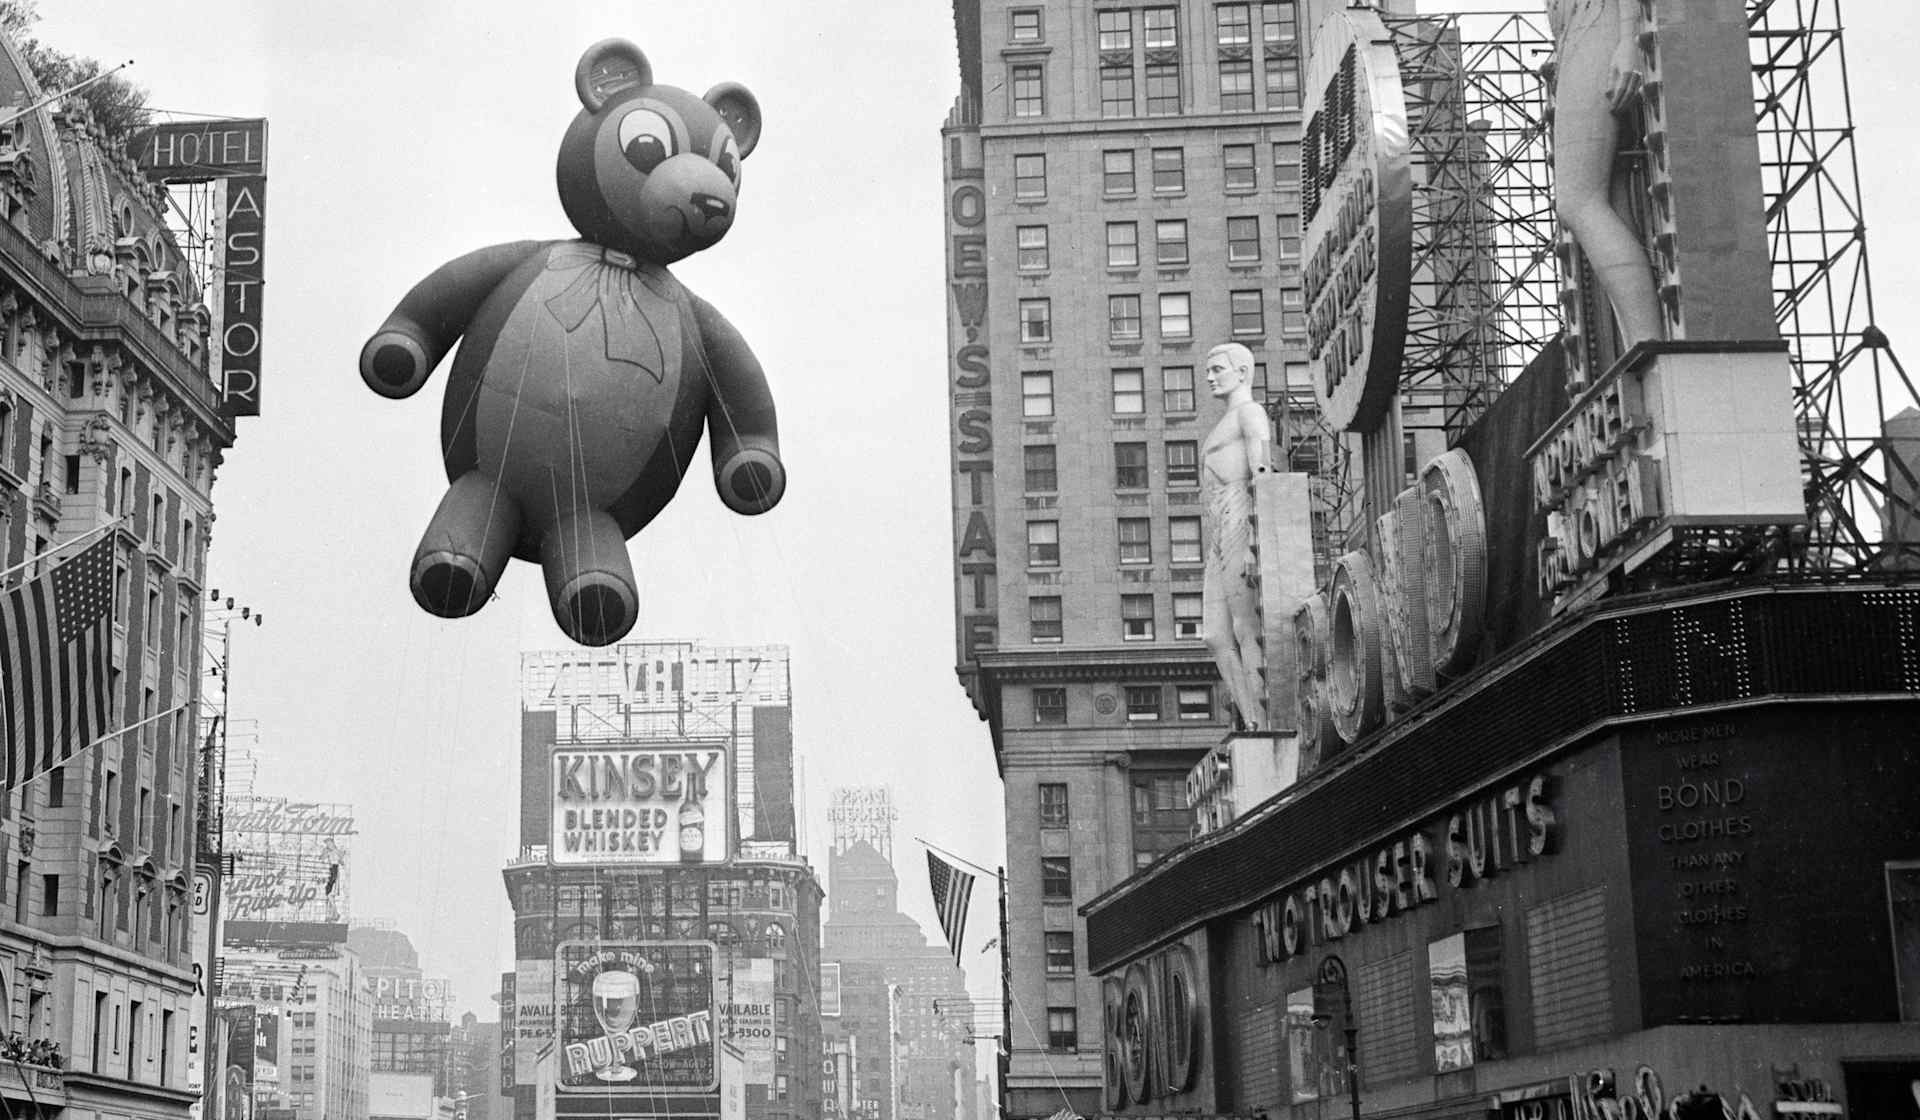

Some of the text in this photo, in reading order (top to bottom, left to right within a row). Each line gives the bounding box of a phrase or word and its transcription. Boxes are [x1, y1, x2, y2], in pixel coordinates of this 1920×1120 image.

[153, 128, 262, 166] HOTEL
[222, 186, 262, 403] ASTOR
[949, 136, 999, 662] LOEW'S STATE
[1296, 447, 1488, 770] BOND
[1656, 724, 1737, 745] MORE MEN
[1675, 751, 1720, 769] WEAR
[558, 752, 719, 801] KINSEY
[1656, 778, 1744, 809] BOND
[565, 808, 668, 831] BLENDED
[1657, 815, 1752, 842] CLOTHES
[563, 830, 665, 852] WHISKEY
[1253, 775, 1556, 964] TWO TROUSER SUITS
[1669, 850, 1745, 869] THAN ANY
[1681, 879, 1737, 897] OTHER
[1678, 906, 1749, 925] CLOTHES
[577, 951, 655, 975] make mine
[1681, 960, 1754, 979] AMERICA
[719, 1004, 771, 1016] VAILABLE
[565, 1010, 711, 1076] RUPPERT
